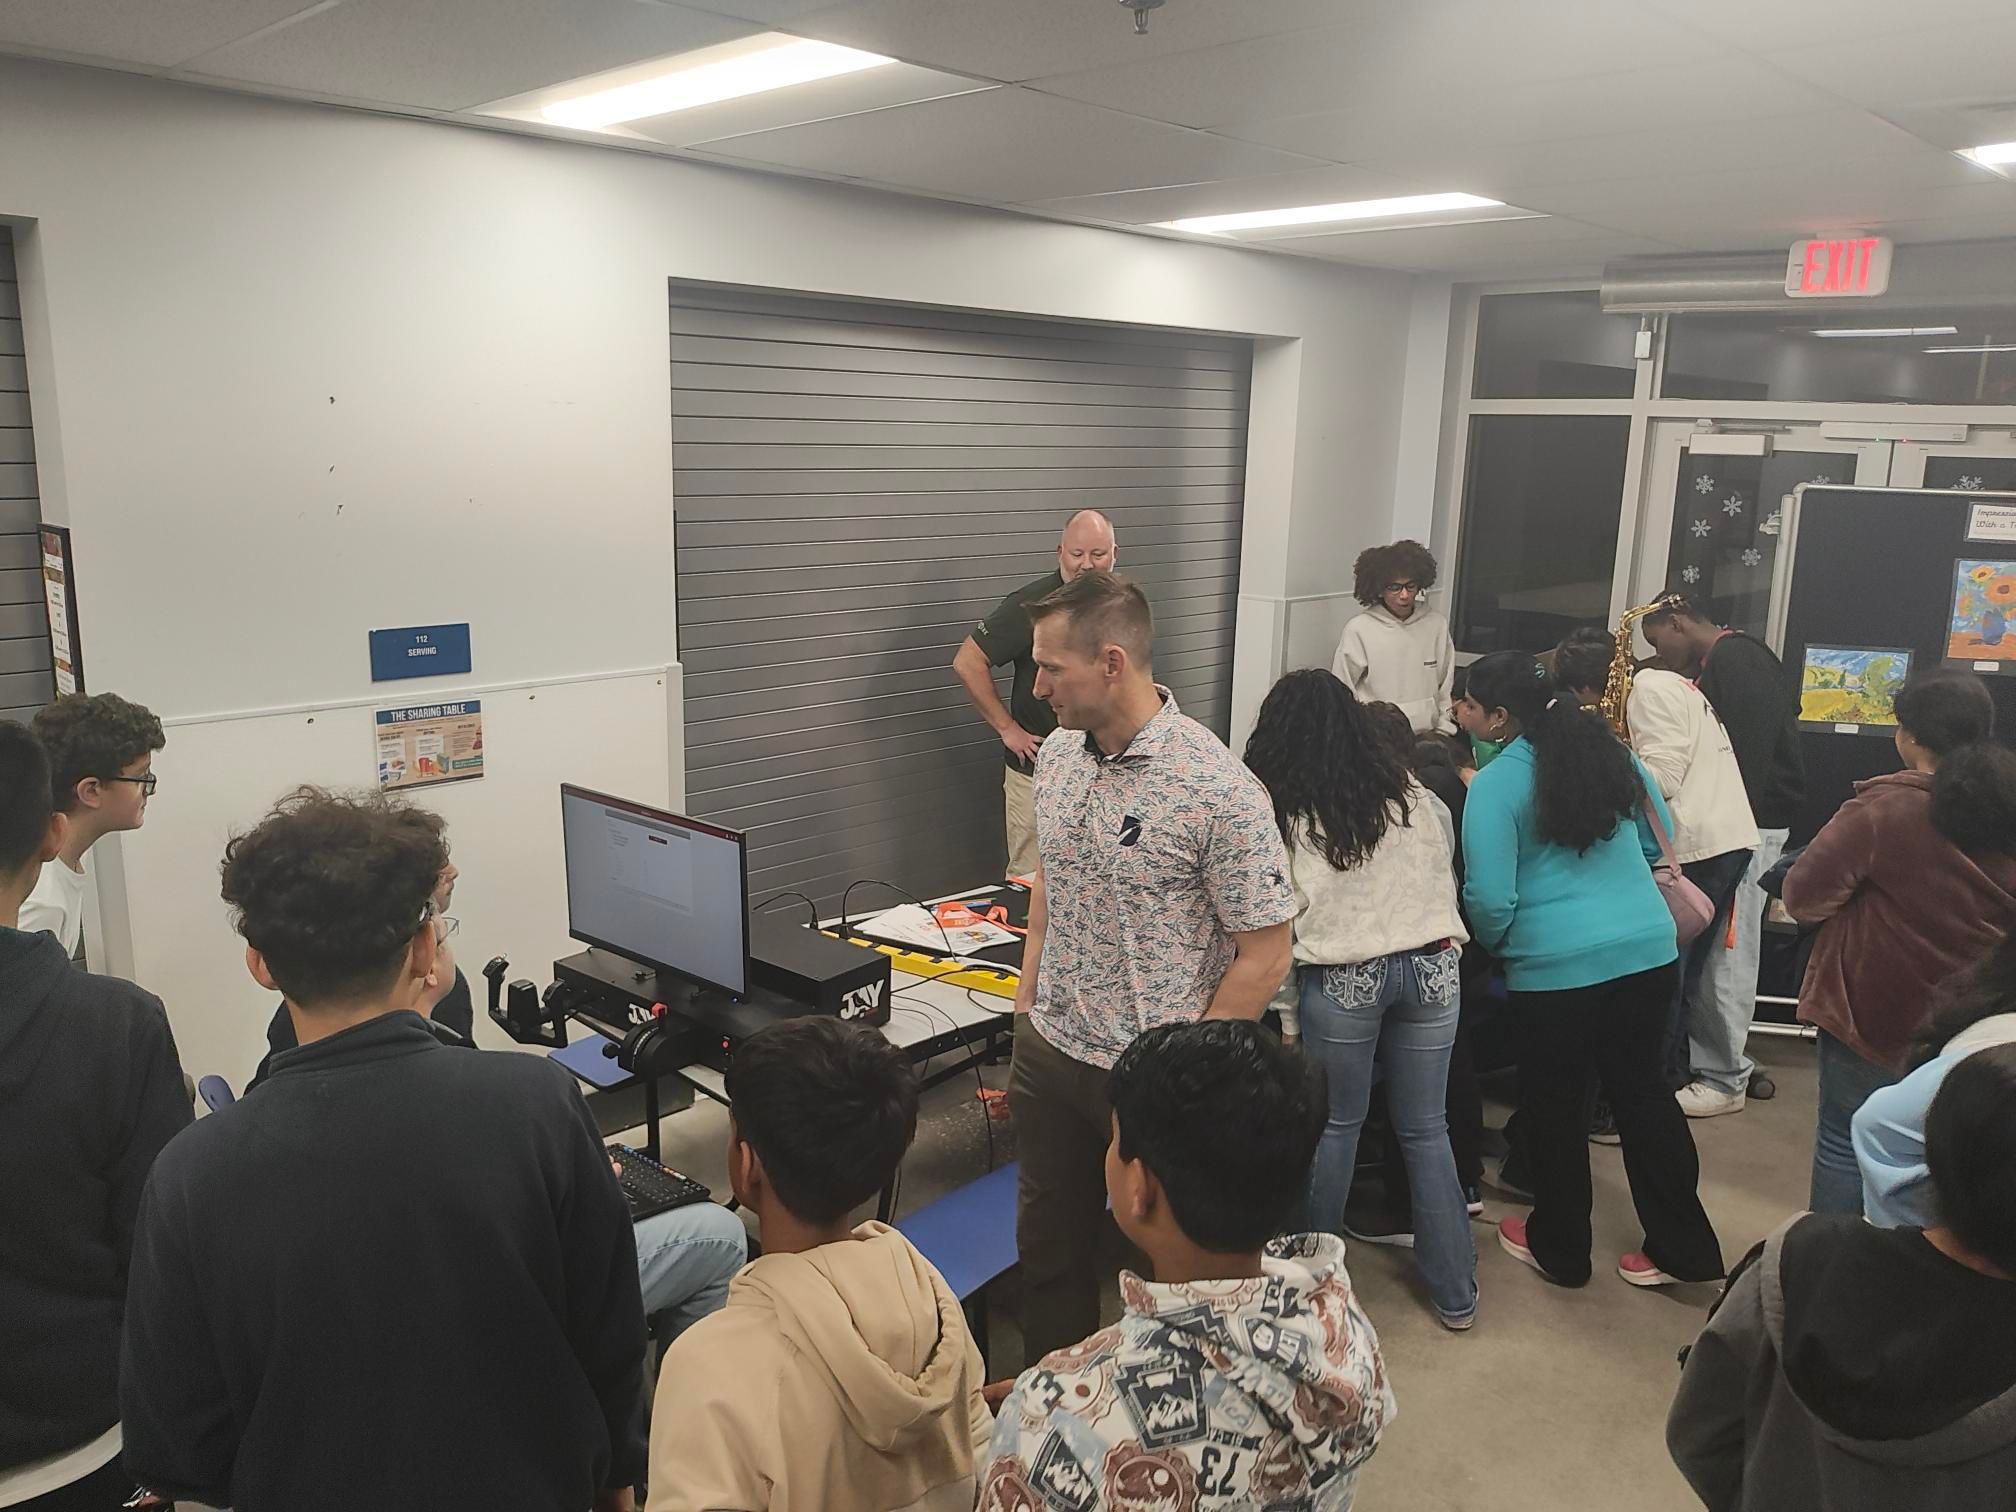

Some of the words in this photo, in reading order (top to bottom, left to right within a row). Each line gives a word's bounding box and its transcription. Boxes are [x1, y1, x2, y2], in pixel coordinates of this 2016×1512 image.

[1801, 238, 1880, 294] EXIT
[1976, 519, 1997, 528] With
[415, 635, 428, 643] 112
[408, 646, 437, 657] SERVING
[391, 709, 406, 721] THE
[408, 705, 442, 720] SHARING
[443, 703, 466, 715] TABLE
